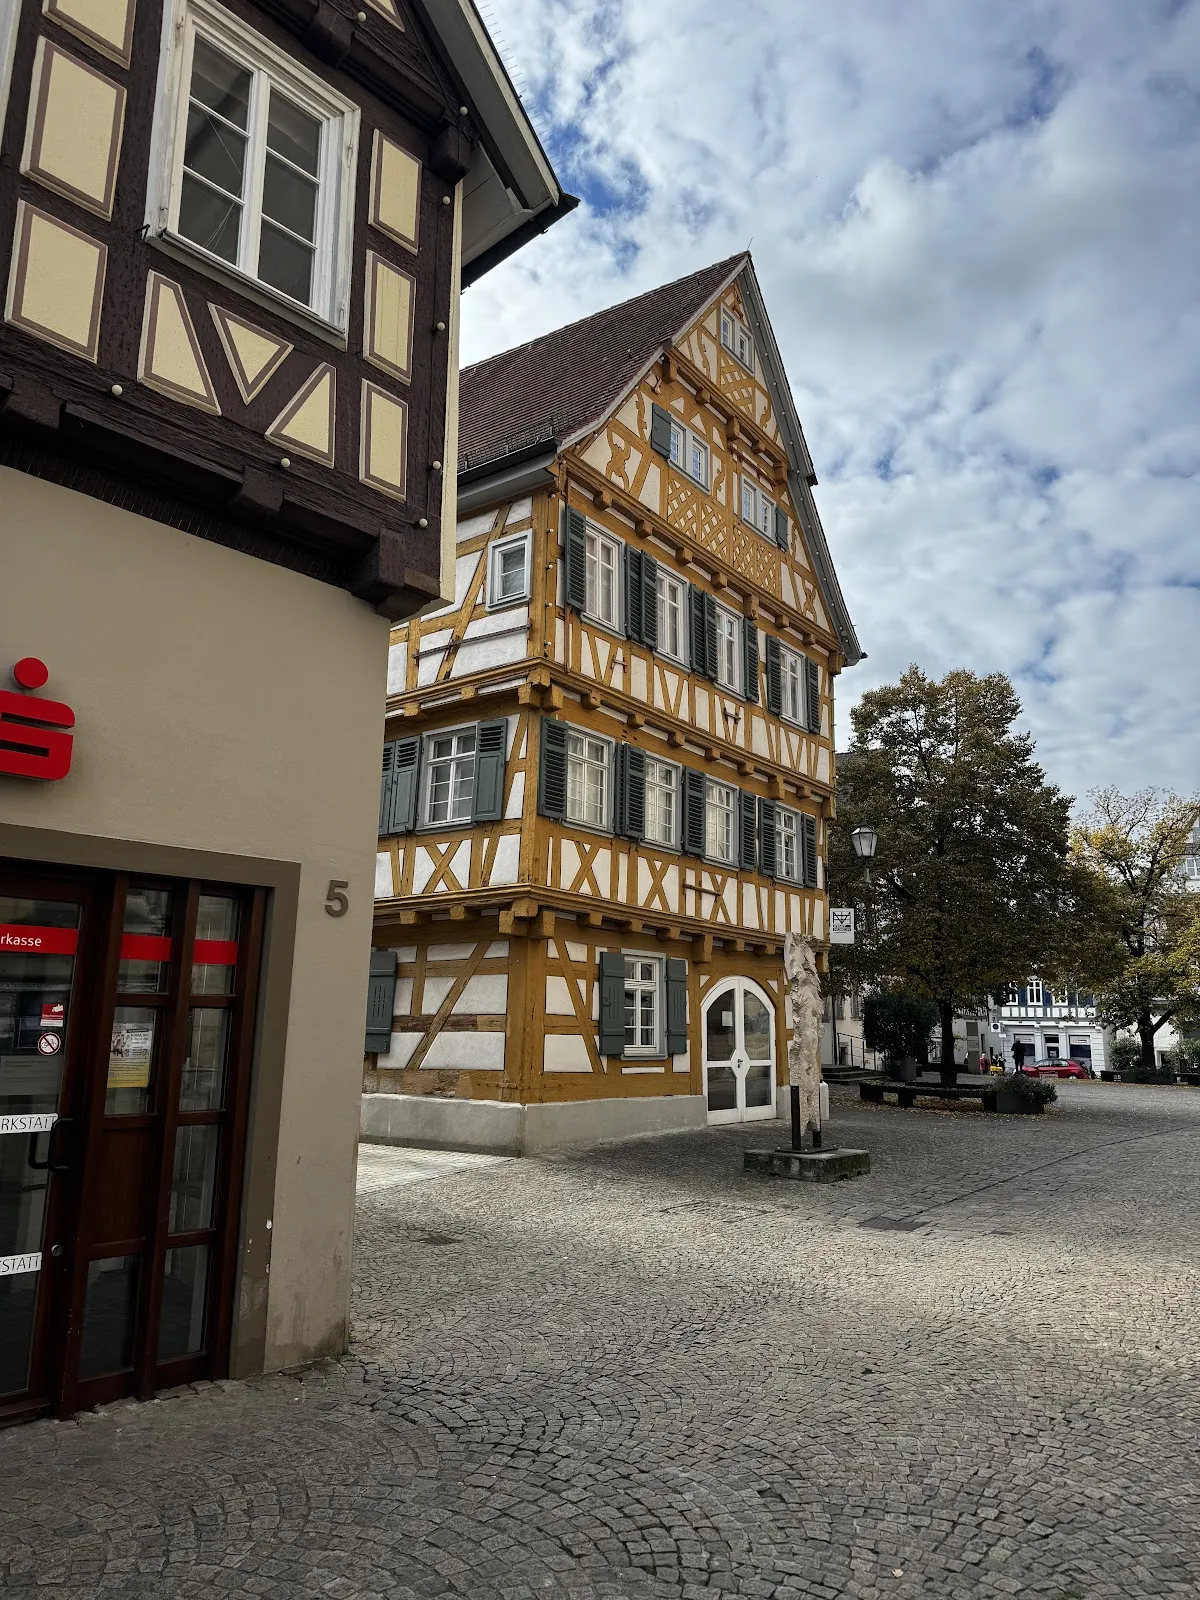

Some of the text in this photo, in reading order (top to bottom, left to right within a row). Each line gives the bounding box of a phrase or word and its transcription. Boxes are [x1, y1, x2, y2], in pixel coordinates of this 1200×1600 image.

[324, 879, 349, 917] 5
[0, 932, 42, 946] rkasse
[0, 1255, 42, 1273] STATT
